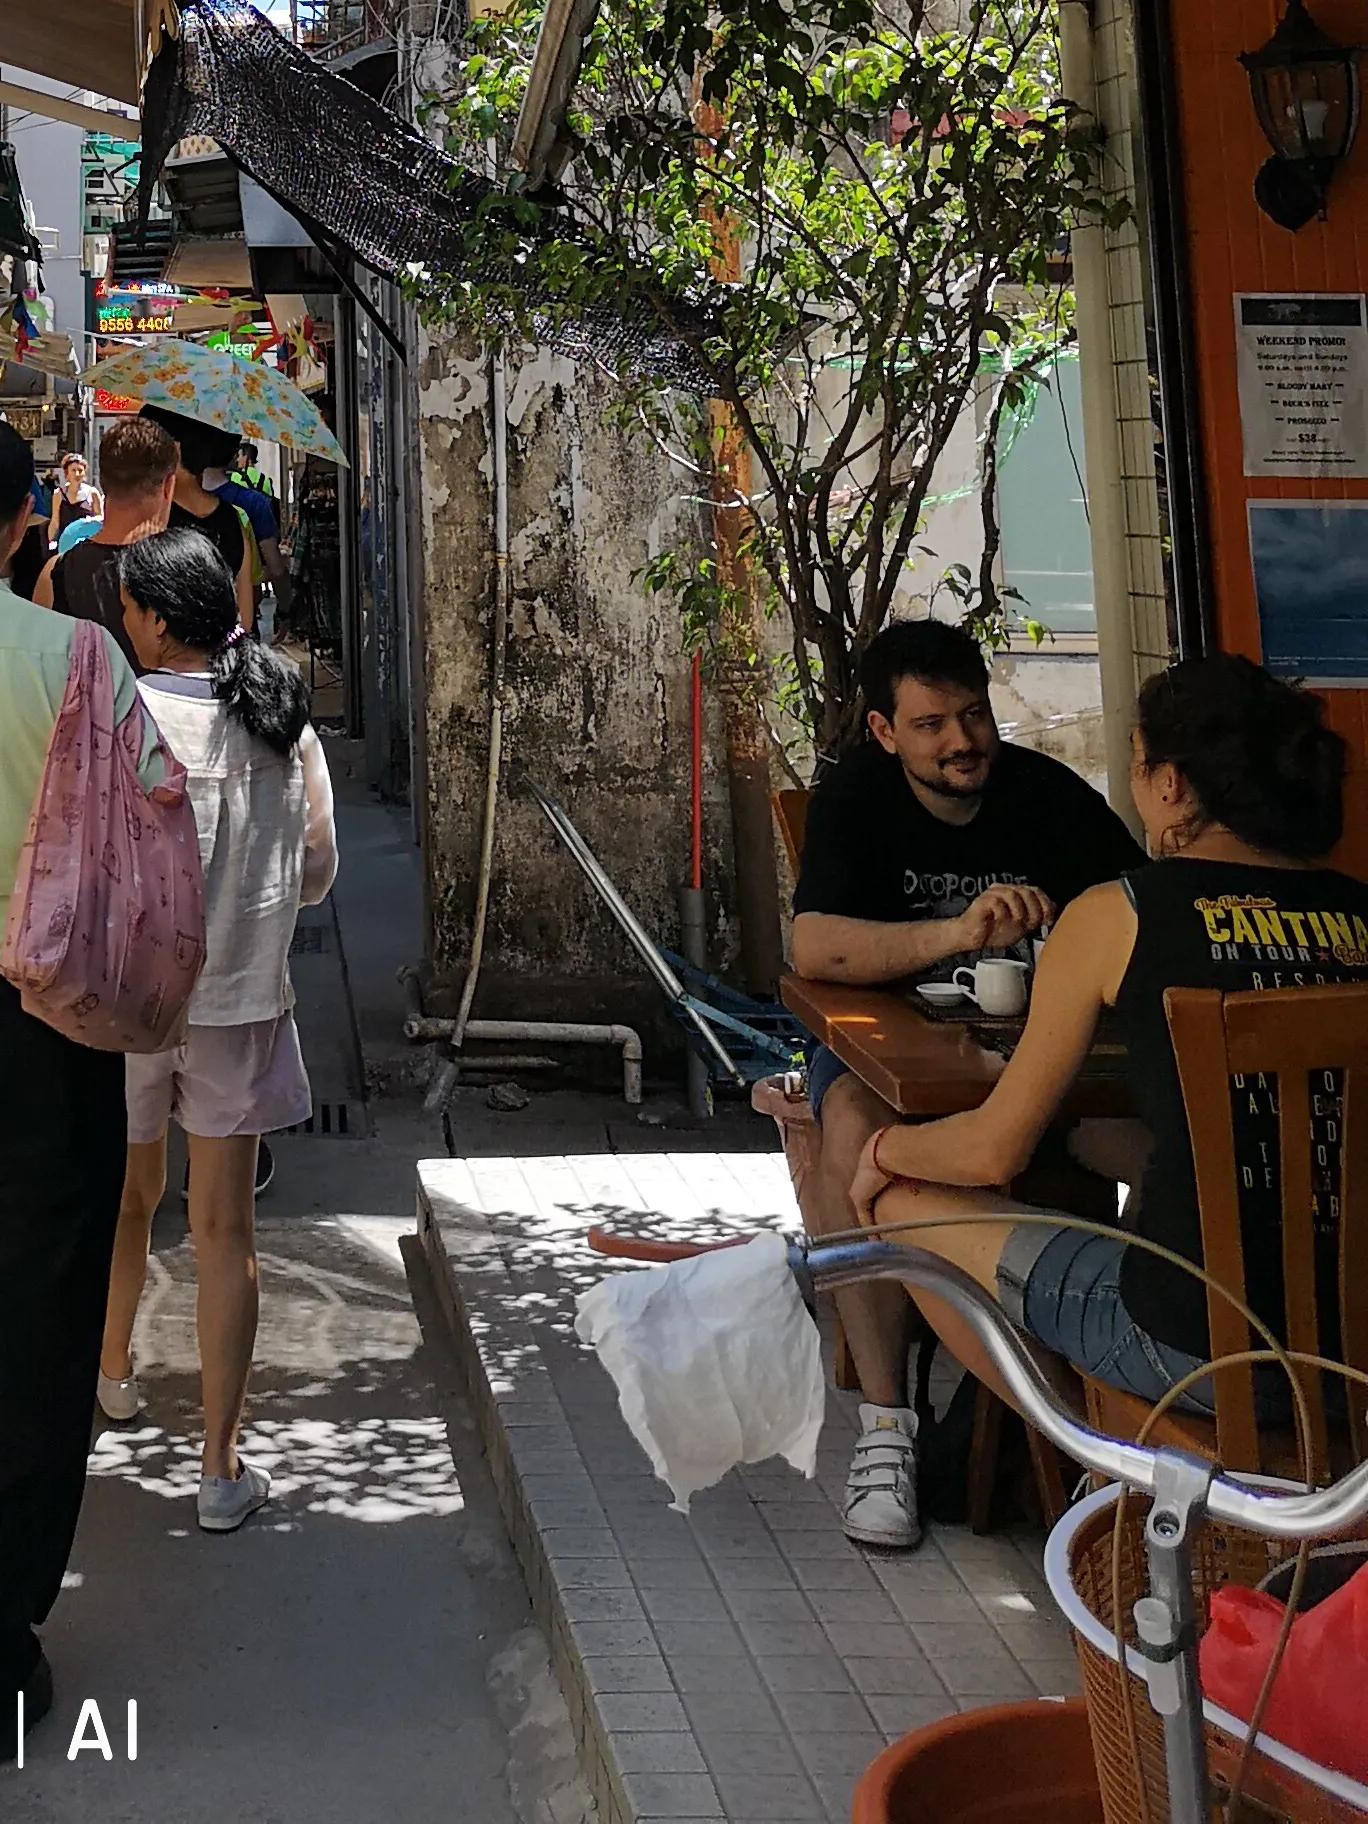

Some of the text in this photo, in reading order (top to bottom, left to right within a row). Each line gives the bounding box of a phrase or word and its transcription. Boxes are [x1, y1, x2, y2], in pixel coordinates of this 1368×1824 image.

[1256, 335, 1307, 346] WEEKEND
[1298, 433, 1317, 443] $38
[1202, 907, 1368, 953] CANTINA
[1210, 943, 1240, 961] ON
[1250, 944, 1312, 963] TOUR
